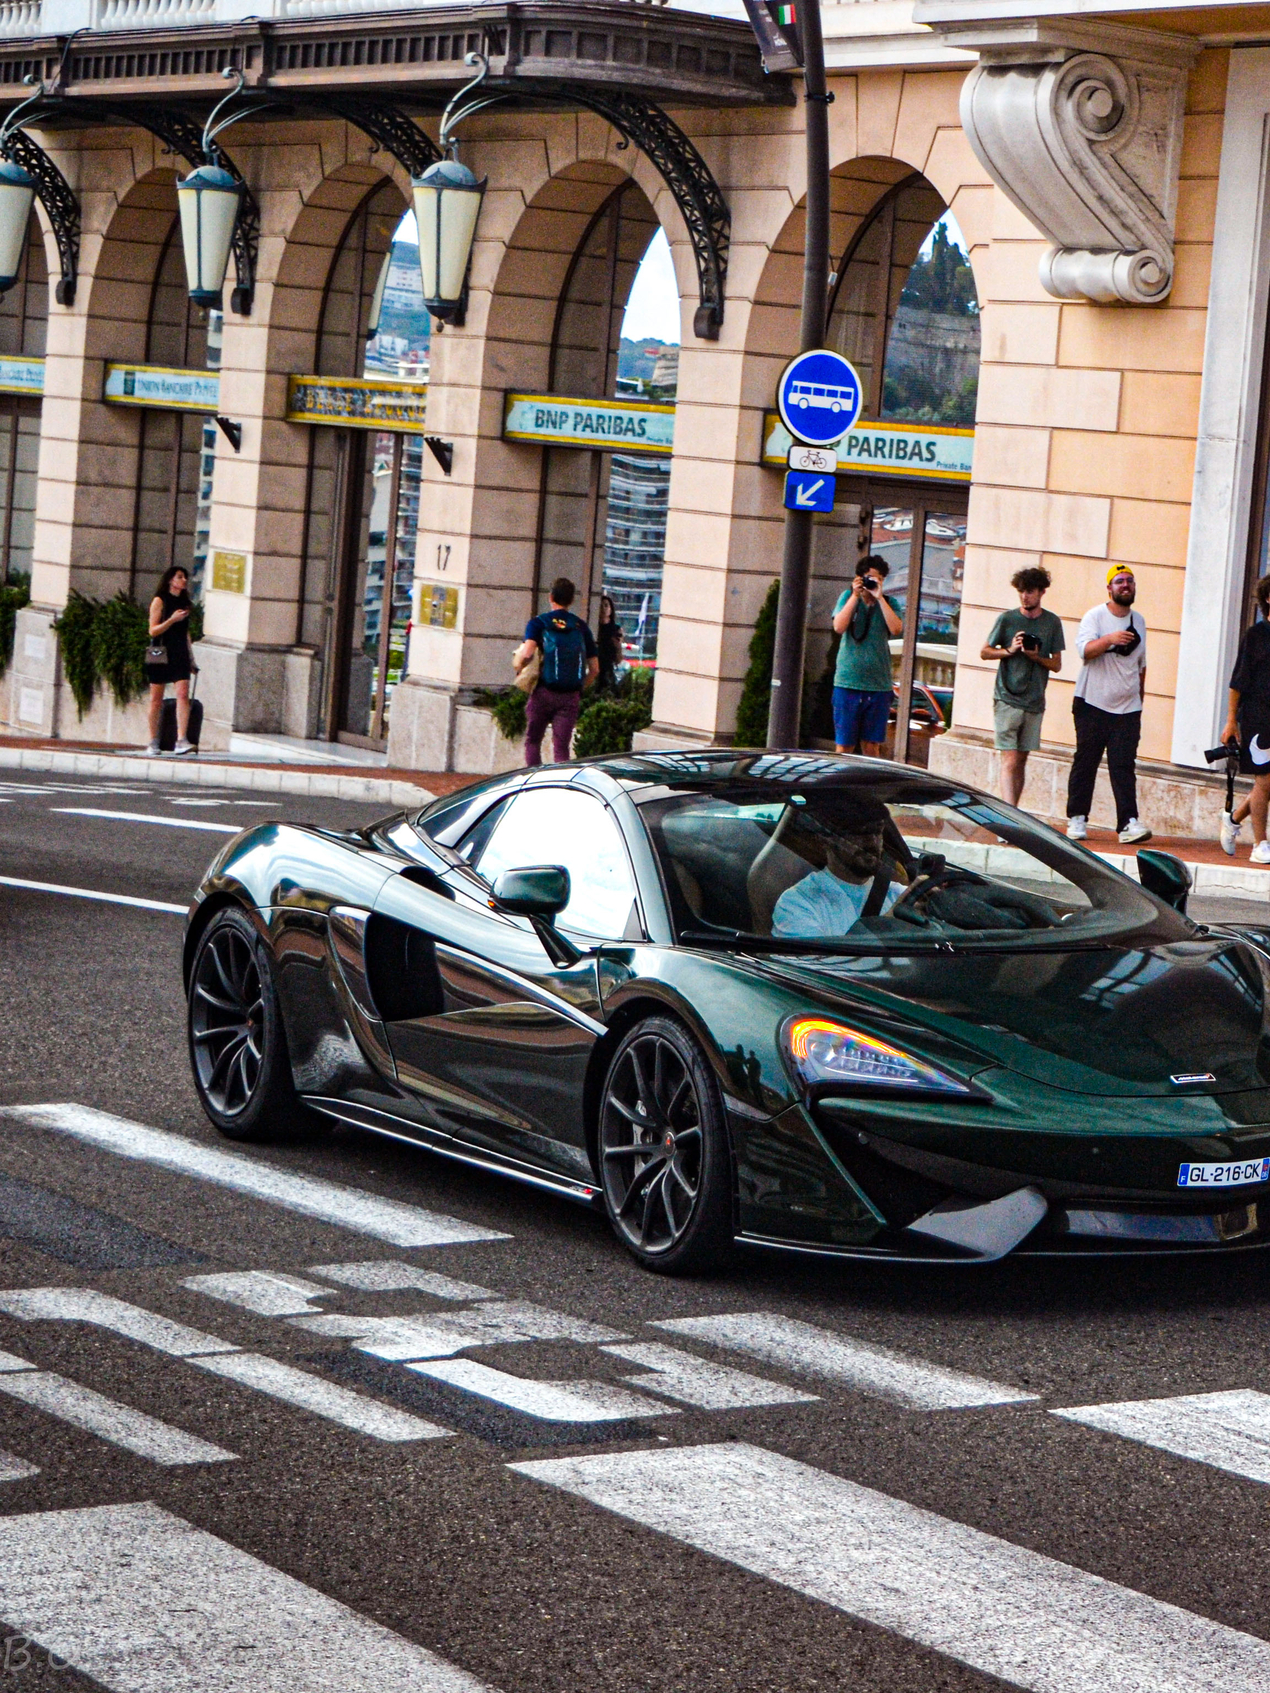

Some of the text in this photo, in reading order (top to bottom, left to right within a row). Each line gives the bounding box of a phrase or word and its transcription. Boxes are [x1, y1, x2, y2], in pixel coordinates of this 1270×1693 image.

[535, 408, 647, 438] BNP PARIBAS
[847, 435, 937, 463] PARIBAS
[936, 460, 972, 471] Private Ban
[437, 544, 451, 571] 17
[1190, 1162, 1261, 1182] GL-216-CK
